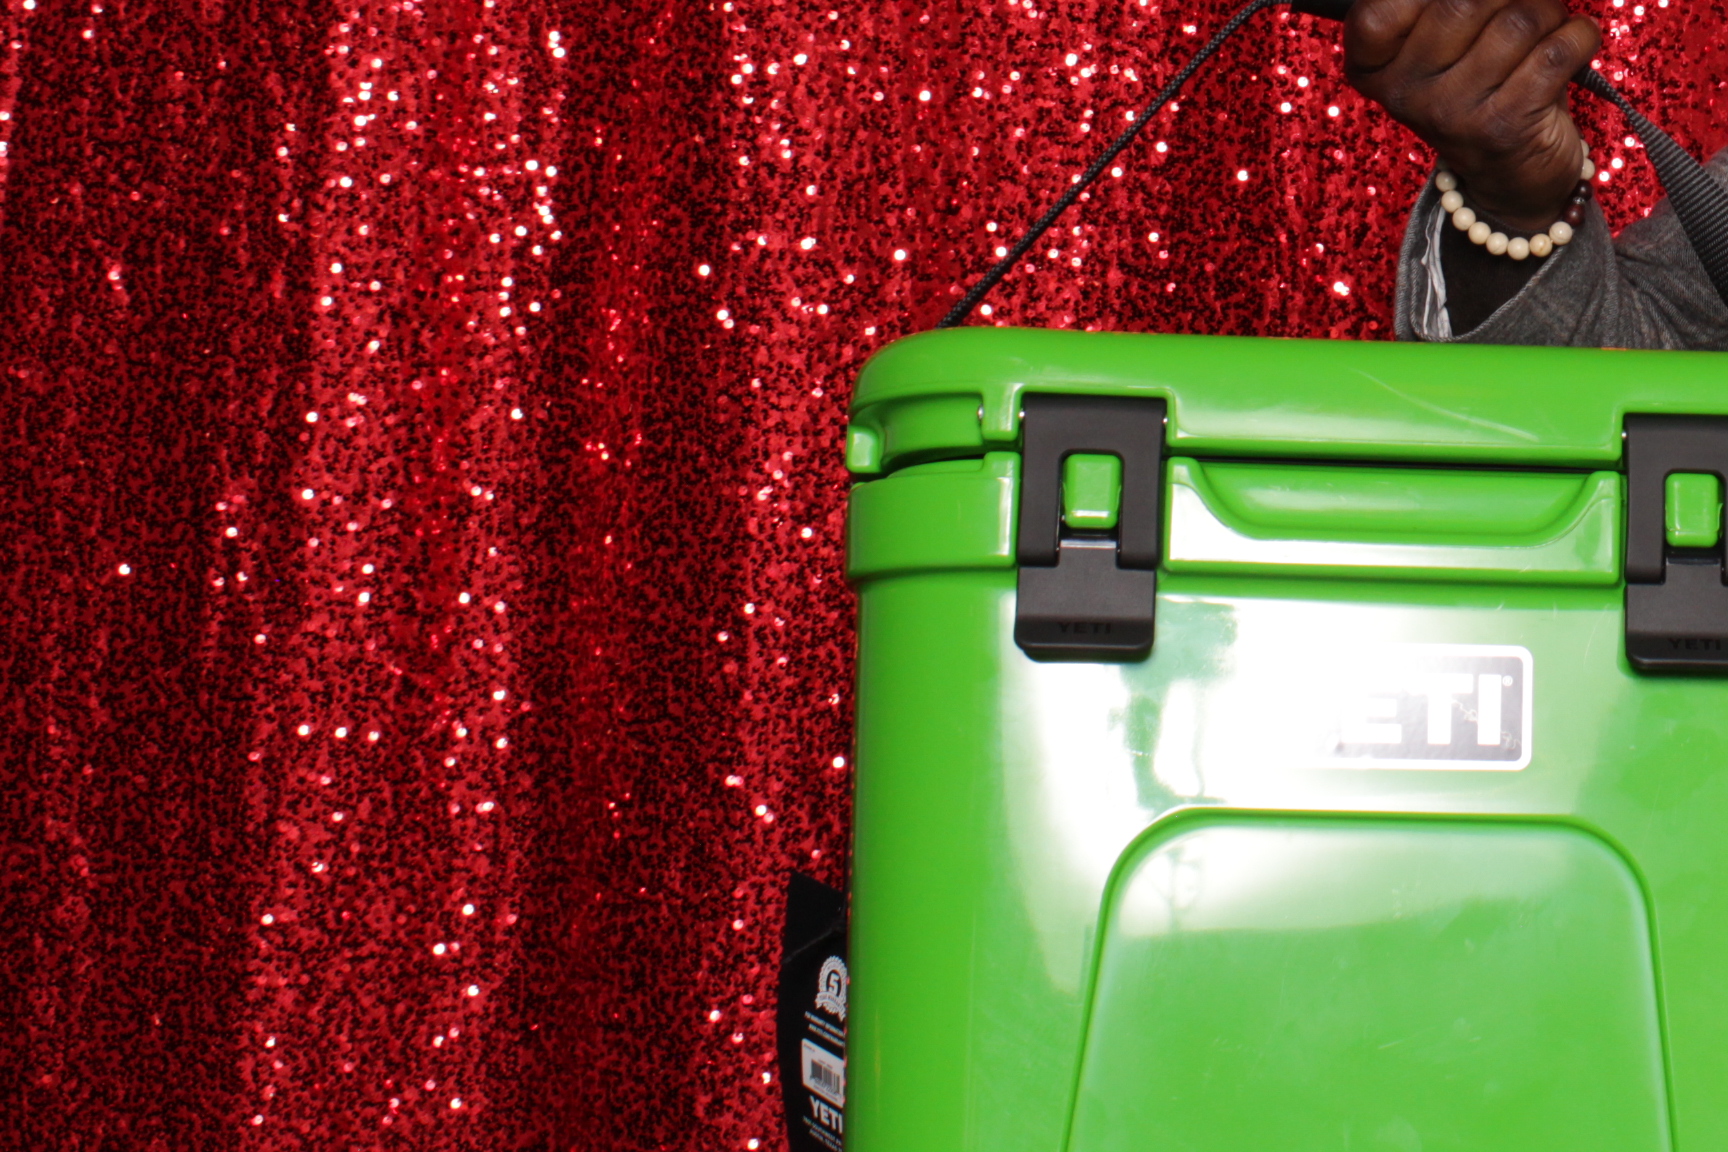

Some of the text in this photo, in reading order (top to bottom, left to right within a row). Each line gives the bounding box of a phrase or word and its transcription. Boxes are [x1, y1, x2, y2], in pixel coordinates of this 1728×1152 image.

[1057, 621, 1112, 634] YETI
[1667, 637, 1721, 651] YETI
[1320, 673, 1502, 746] ETI
[809, 1094, 843, 1135] YETI
